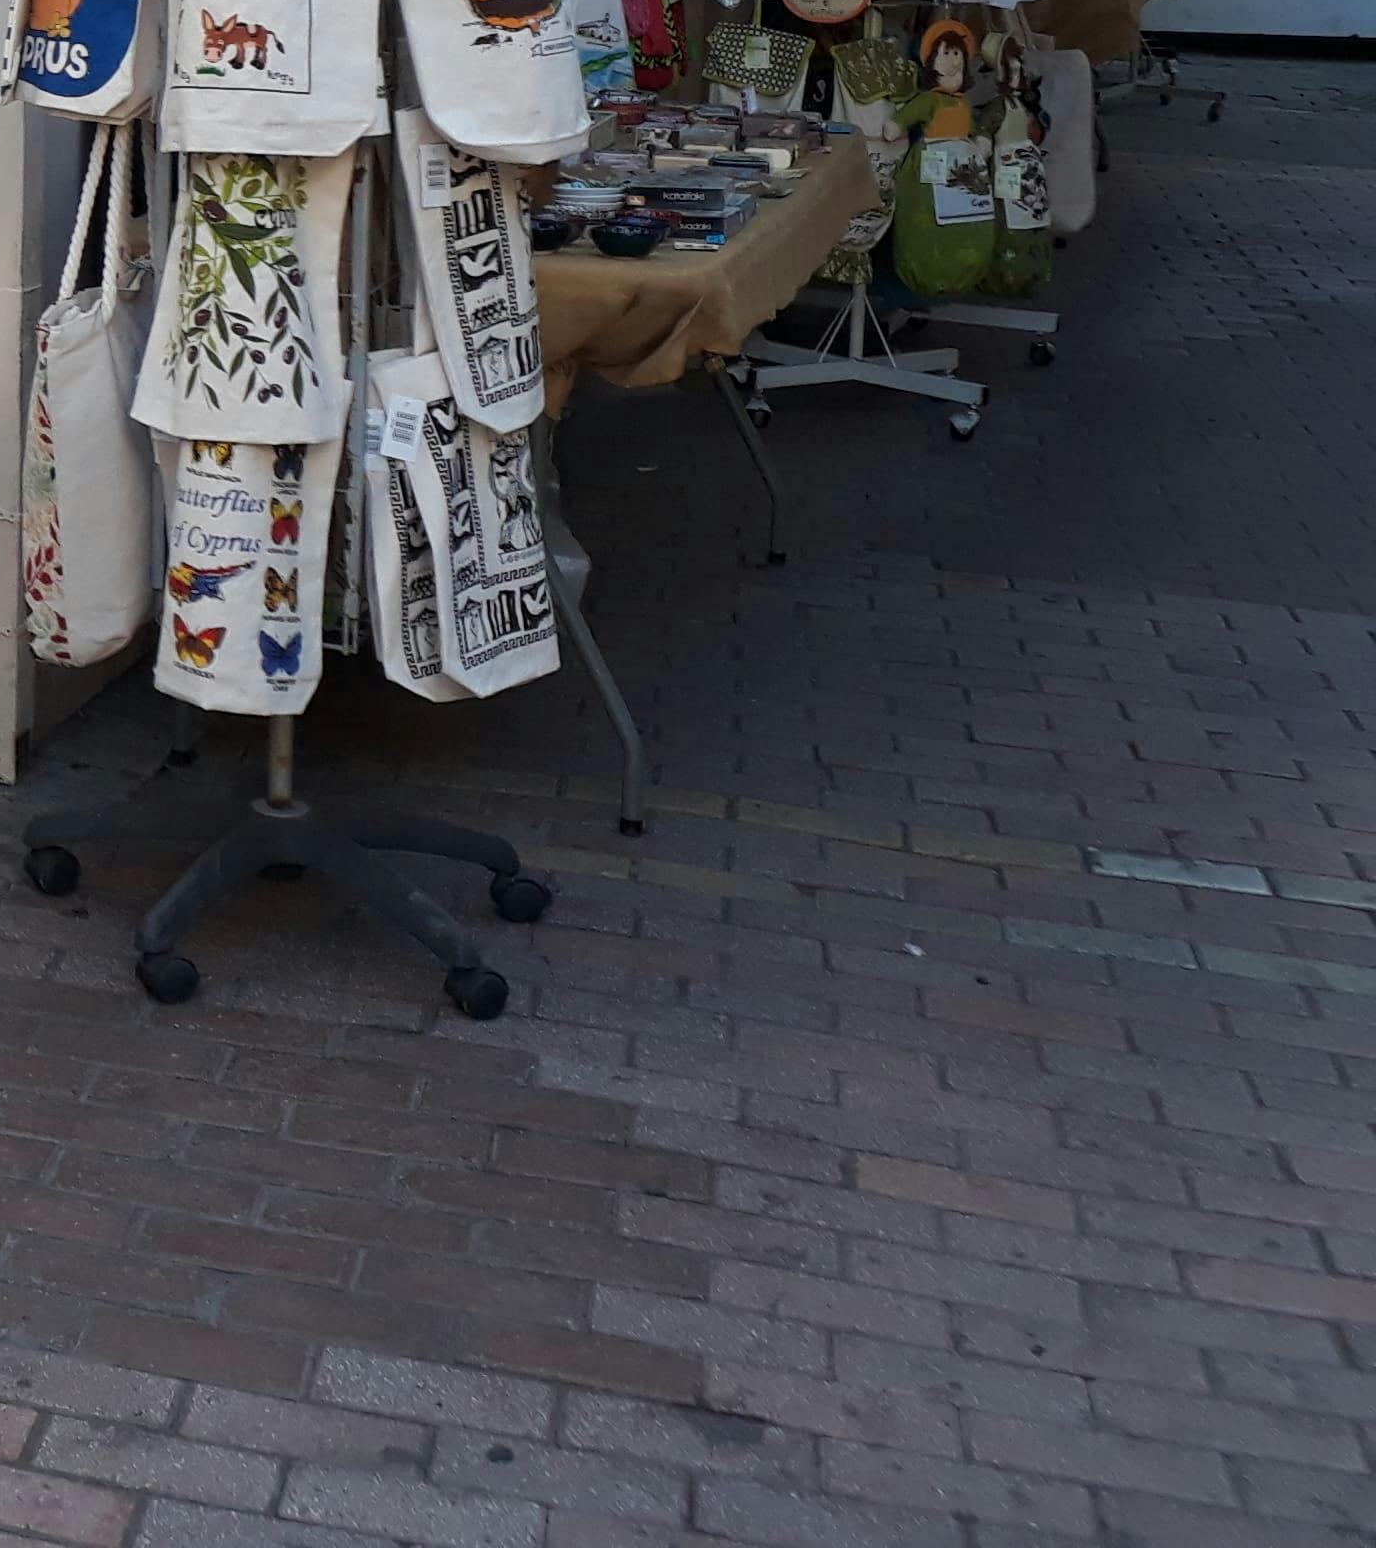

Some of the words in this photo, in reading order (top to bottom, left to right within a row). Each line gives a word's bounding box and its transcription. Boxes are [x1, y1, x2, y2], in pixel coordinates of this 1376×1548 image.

[21, 34, 90, 80] PRUS
[176, 487, 266, 518] utterflies
[187, 525, 263, 557] Cyprus
